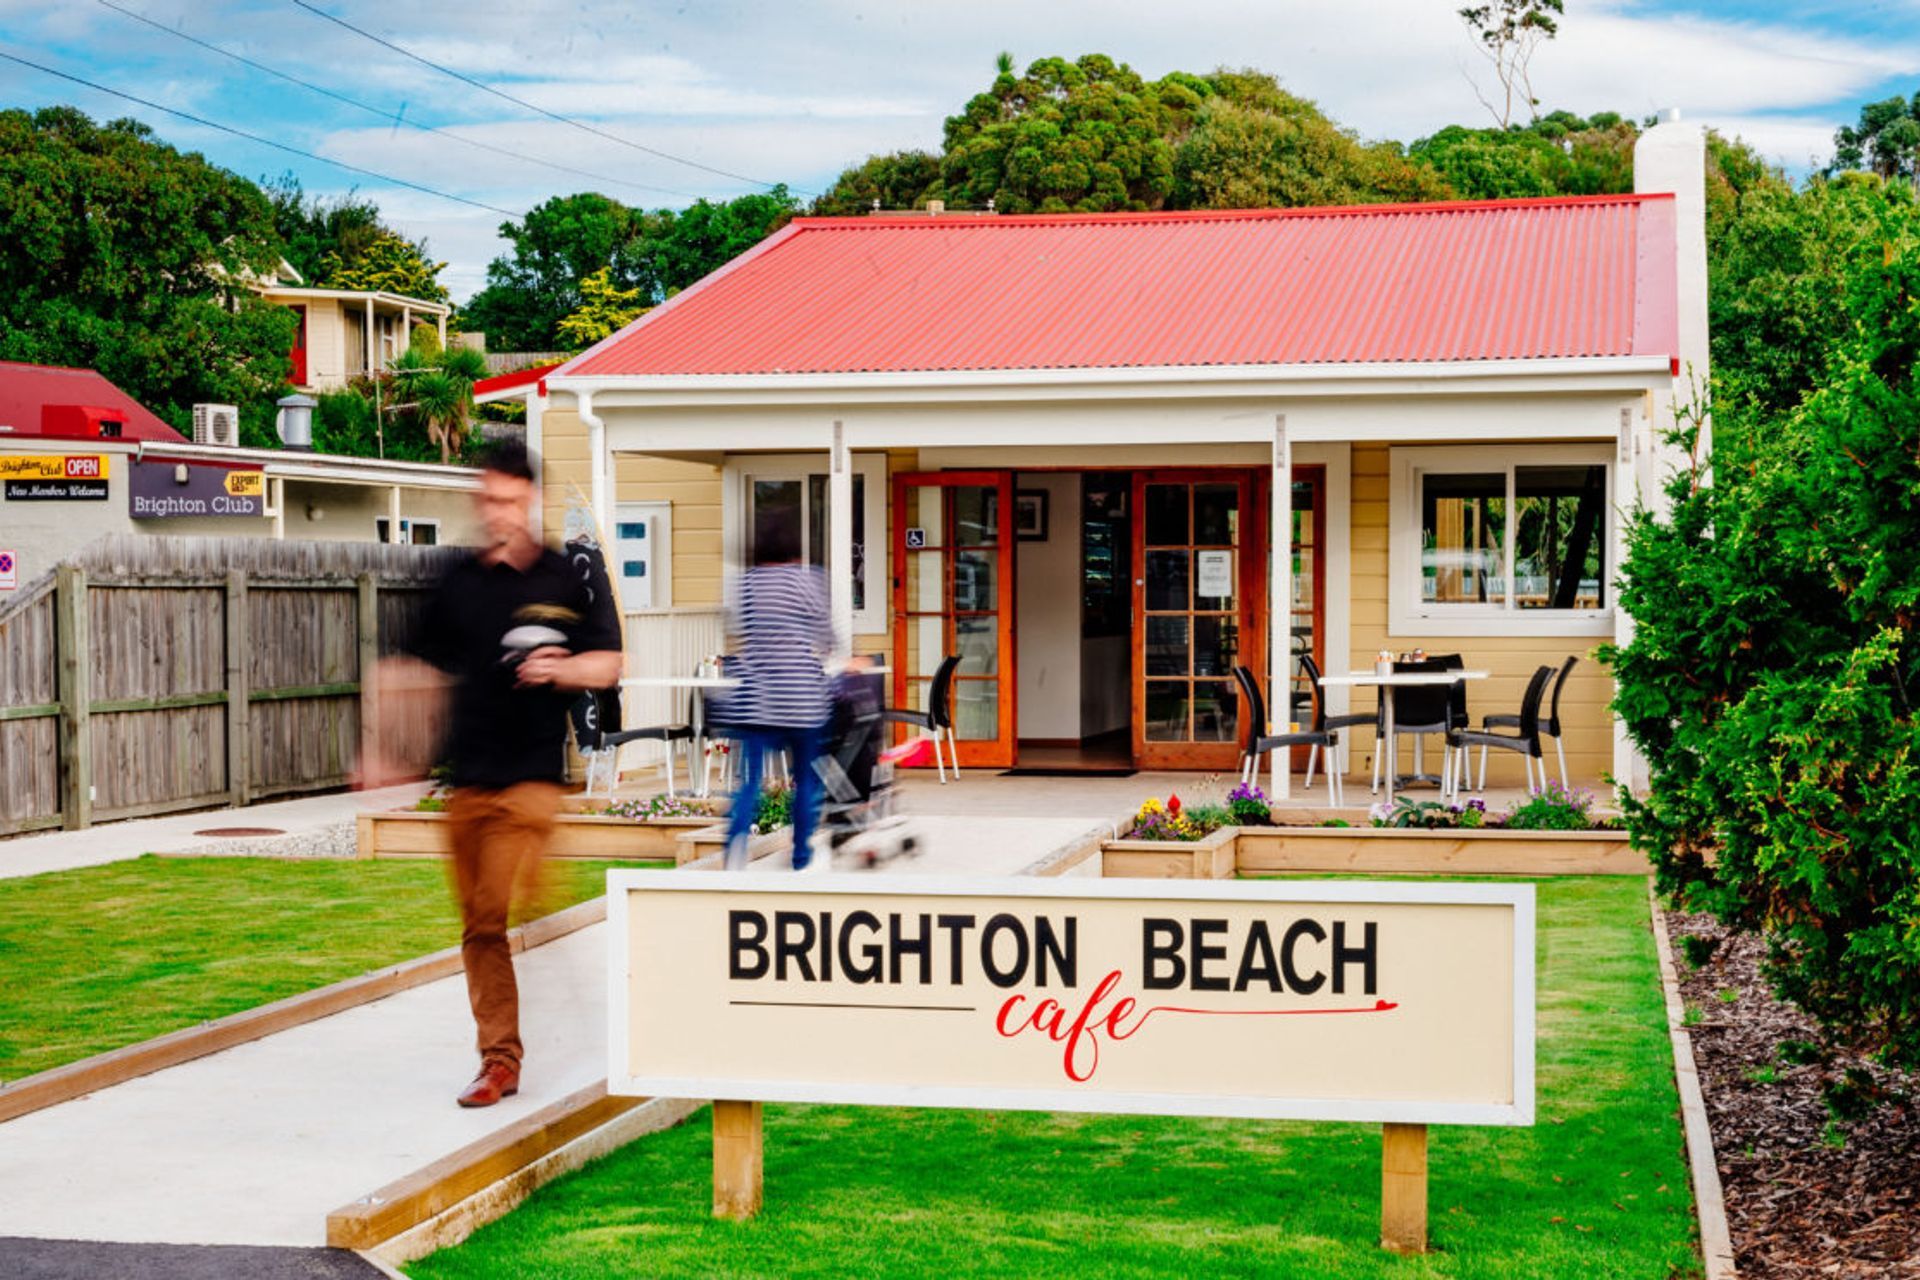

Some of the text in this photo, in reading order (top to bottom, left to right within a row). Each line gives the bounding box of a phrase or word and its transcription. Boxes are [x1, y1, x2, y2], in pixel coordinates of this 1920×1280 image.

[40, 462, 63, 476] Club
[67, 459, 99, 475] OPEN
[8, 484, 106, 496] New Members Welcome
[134, 496, 254, 516] Brighton Club
[729, 909, 1378, 996] BRIGHTON BEACH
[995, 970, 1155, 1083] cafe
